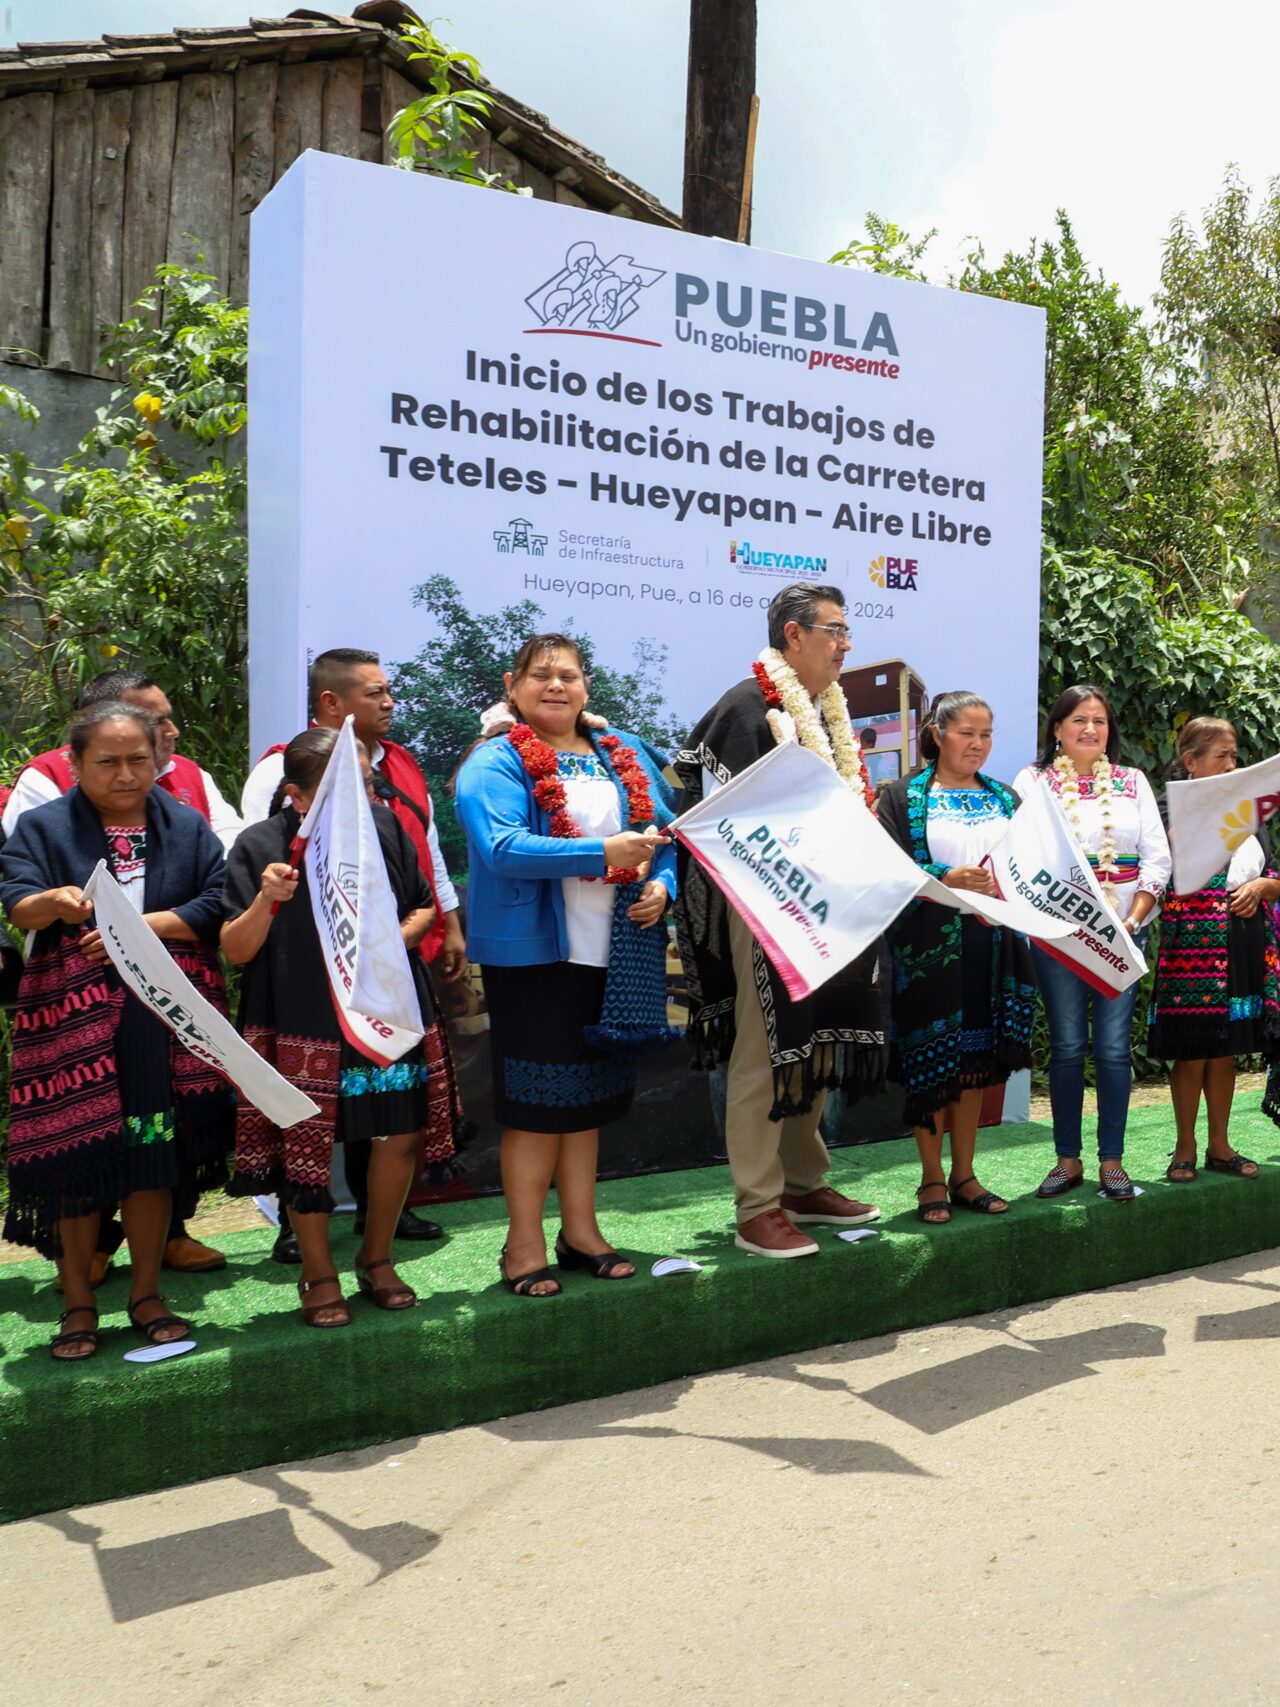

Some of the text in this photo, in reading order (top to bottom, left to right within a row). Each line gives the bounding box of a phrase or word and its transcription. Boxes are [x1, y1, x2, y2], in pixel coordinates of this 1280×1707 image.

[675, 272, 900, 357] PUEBLA
[675, 319, 900, 380] Un gobierno presente
[466, 350, 936, 450] Inicio de los Trabajos de
[391, 392, 985, 503] Rehabilitación de la Carretera
[380, 446, 547, 495] Teteles
[590, 472, 797, 527] Hueyapan
[832, 502, 904, 537] Aire
[912, 511, 992, 547] Libre
[559, 530, 631, 549] Secretaría
[559, 546, 684, 569] de Infraestructura
[730, 540, 827, 572] HUEYAPAN
[886, 556, 918, 577] PUE
[524, 573, 635, 600] Hueyapan,
[689, 590, 701, 604] a
[707, 588, 724, 606] 16
[730, 592, 754, 609] de
[854, 602, 895, 620] 2024
[886, 573, 918, 592] BLA
[717, 818, 735, 843] Un
[729, 839, 788, 902] gobierno
[746, 824, 830, 926] PUEBLA
[1008, 856, 1130, 973] Un gobiern presente
[1031, 868, 1118, 944] PUEBLA
